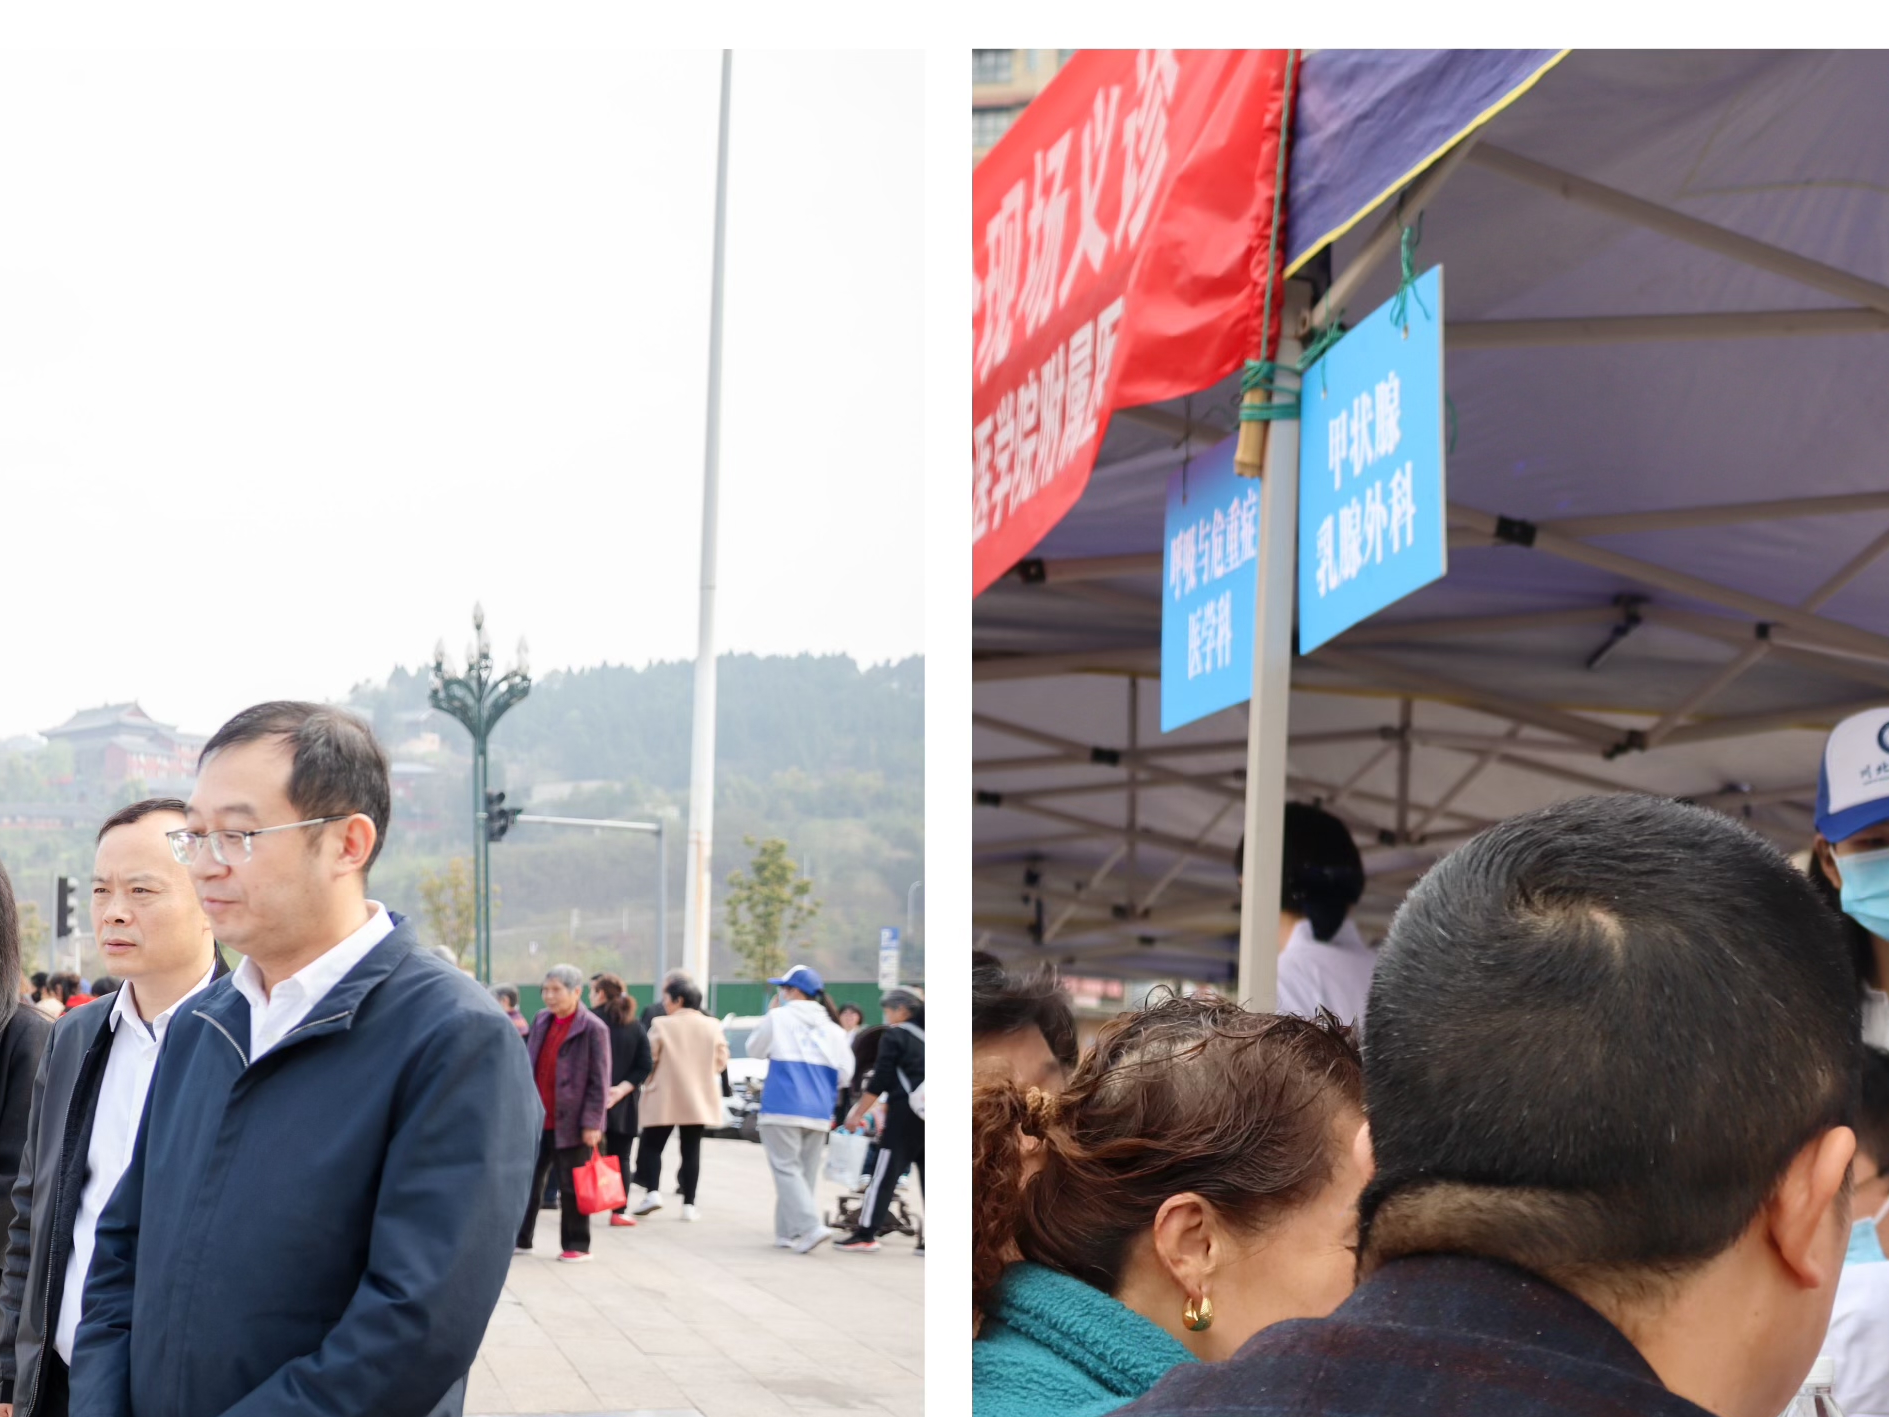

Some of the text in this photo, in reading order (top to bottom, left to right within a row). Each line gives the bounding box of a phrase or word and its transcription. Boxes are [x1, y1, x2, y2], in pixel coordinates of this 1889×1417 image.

[972, 49, 1179, 383] 现场义诊
[1328, 370, 1402, 491] 甲状腺
[1315, 461, 1417, 598] 乳腺外科
[1187, 589, 1232, 680] 医学科
